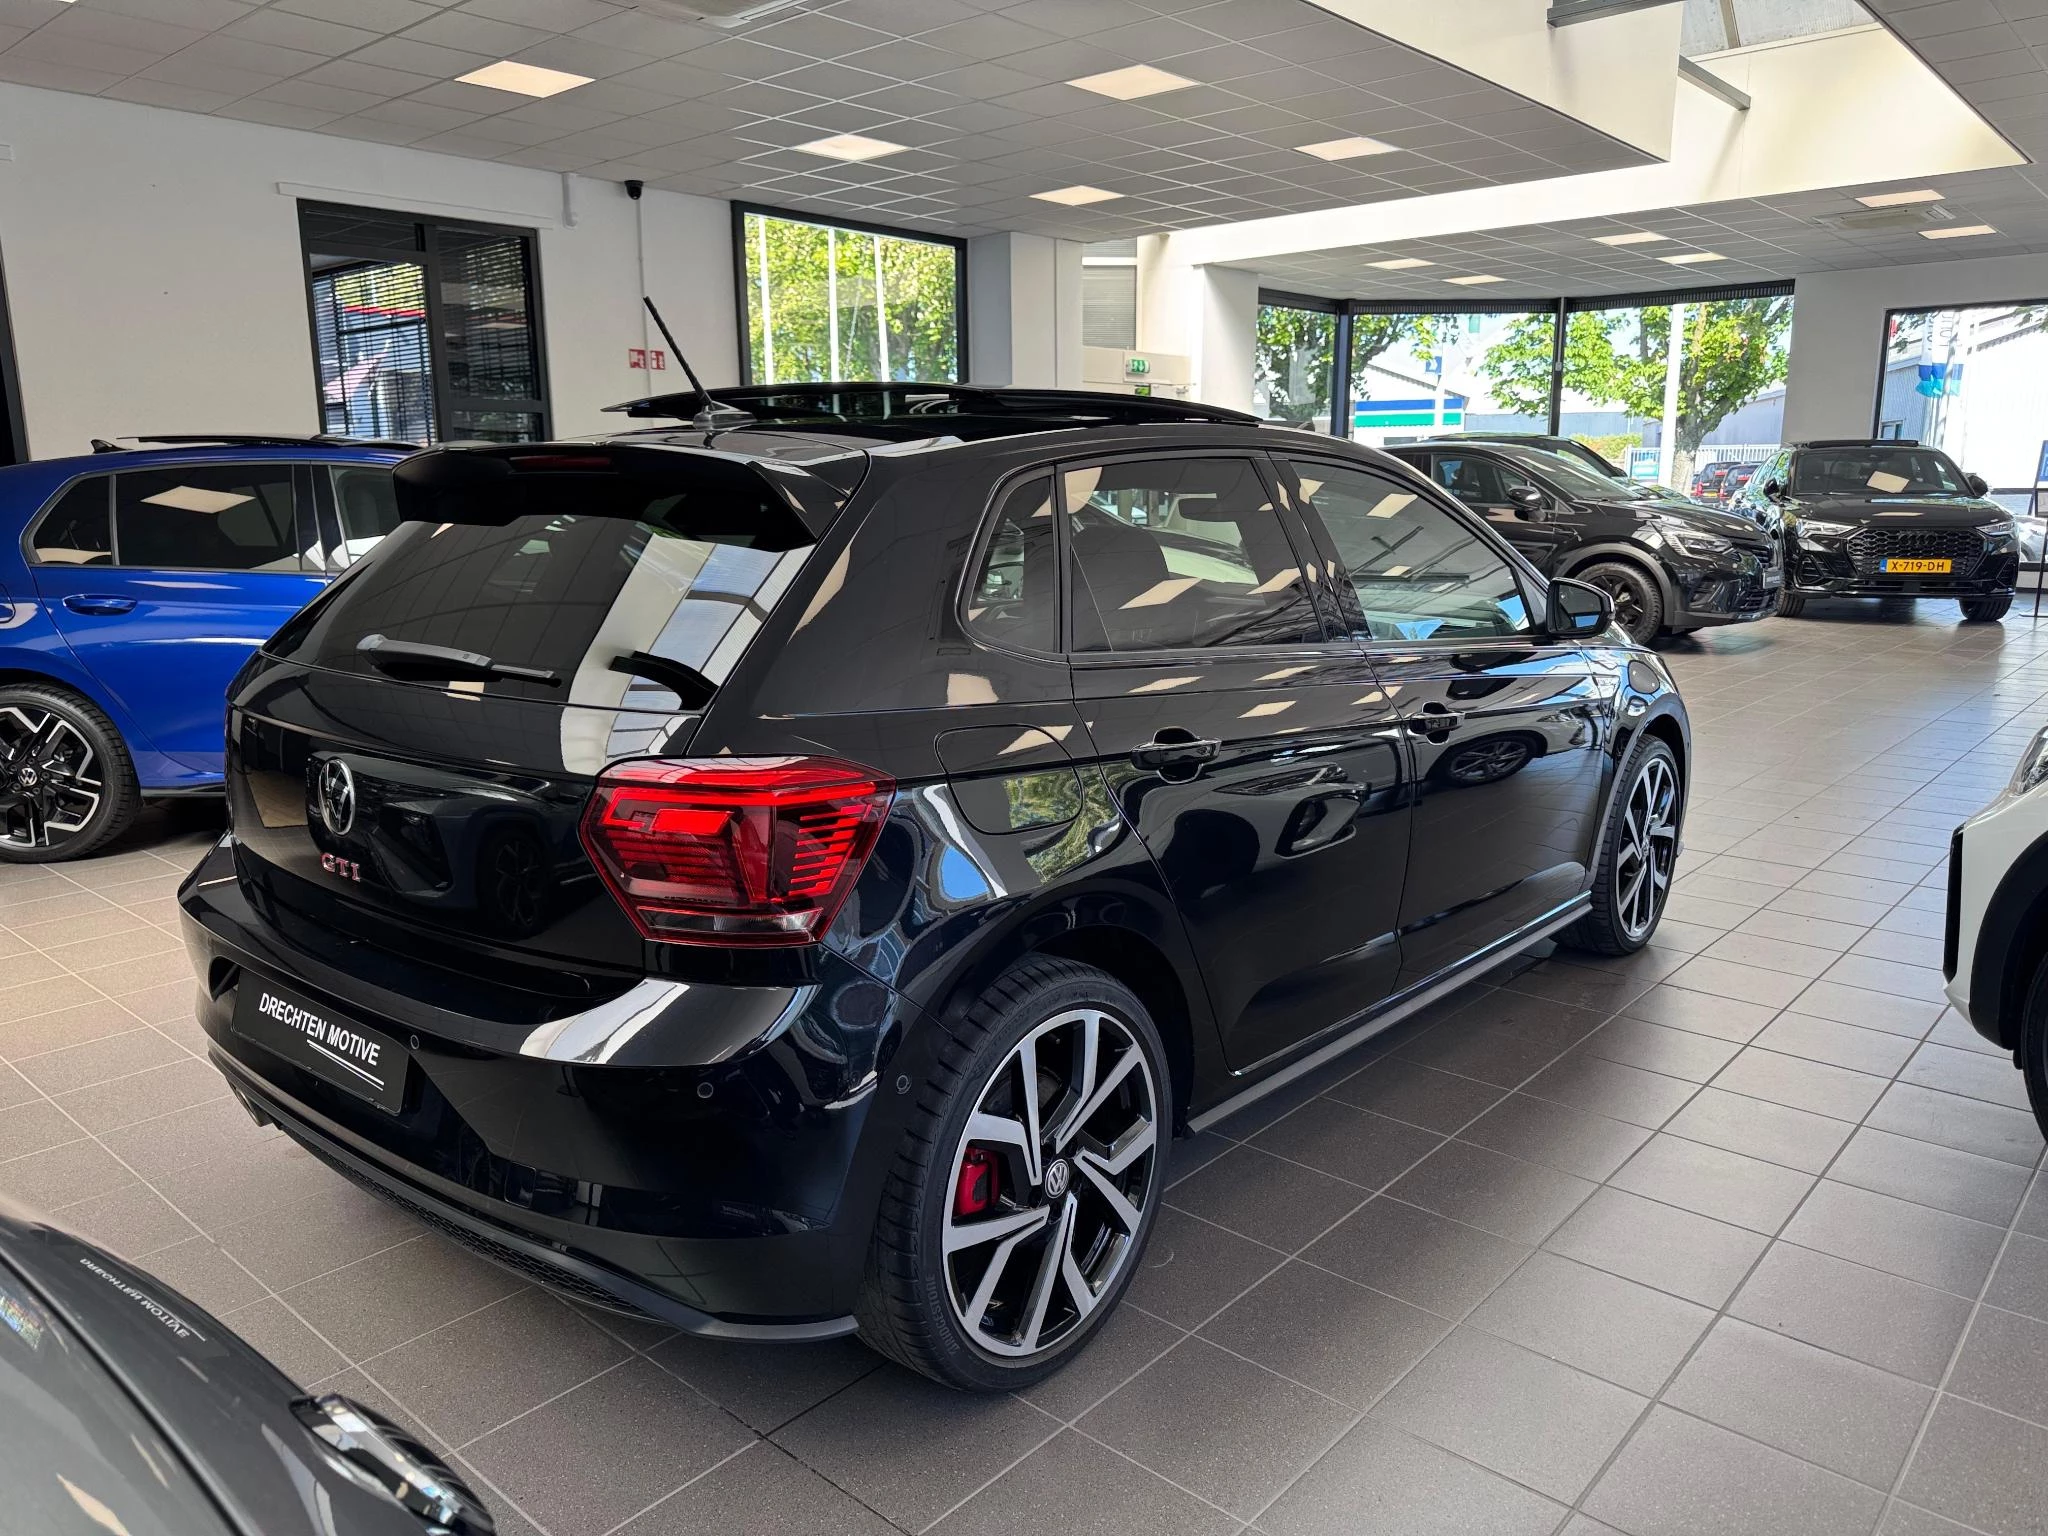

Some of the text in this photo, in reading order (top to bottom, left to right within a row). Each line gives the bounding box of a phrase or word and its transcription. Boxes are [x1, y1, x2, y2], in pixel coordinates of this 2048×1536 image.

[1892, 561, 1944, 571] X-719-DH
[321, 852, 360, 881] GTI
[258, 992, 381, 1066] DRECHTEN MOTIVE
